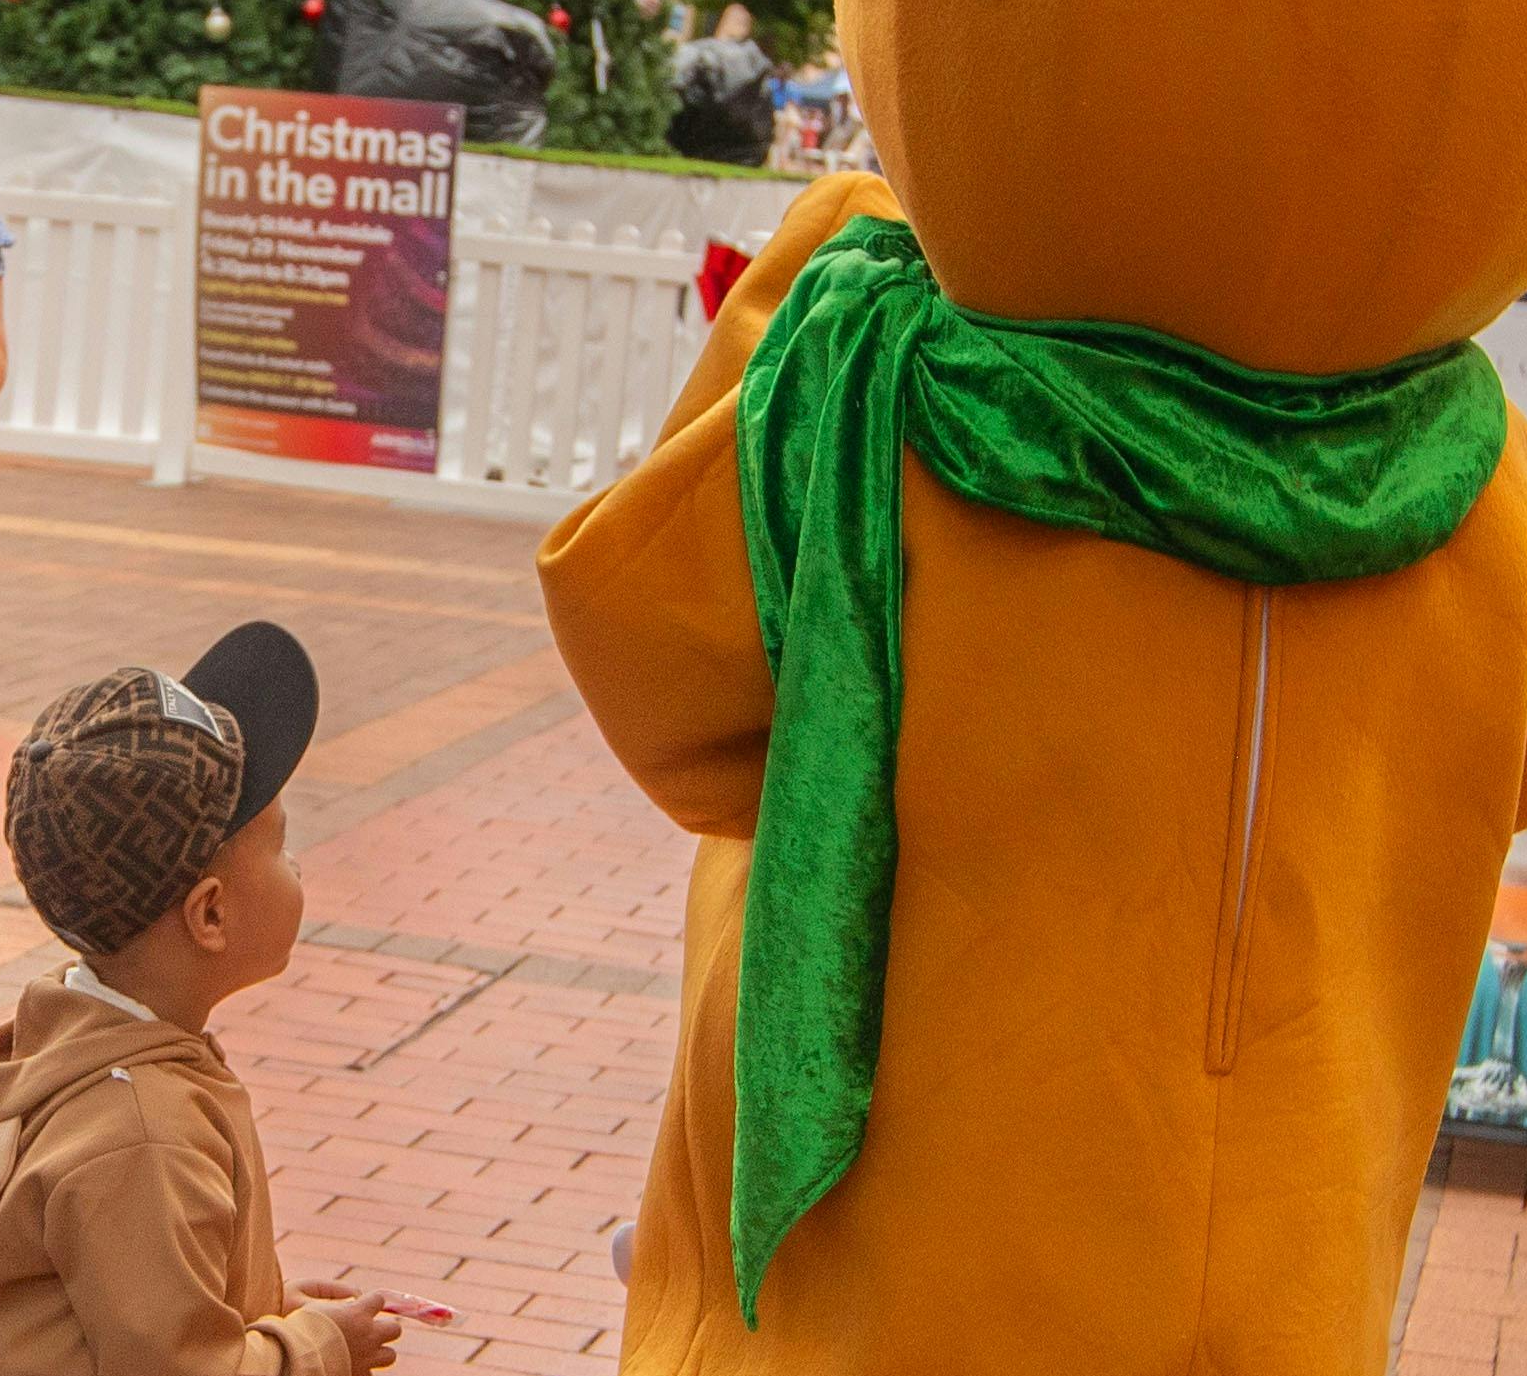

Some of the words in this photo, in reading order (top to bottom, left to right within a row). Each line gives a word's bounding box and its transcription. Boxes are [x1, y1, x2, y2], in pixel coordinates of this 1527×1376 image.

[205, 104, 453, 168] Christmas
[203, 153, 246, 202] in
[256, 160, 338, 209] the
[344, 170, 450, 220] mall
